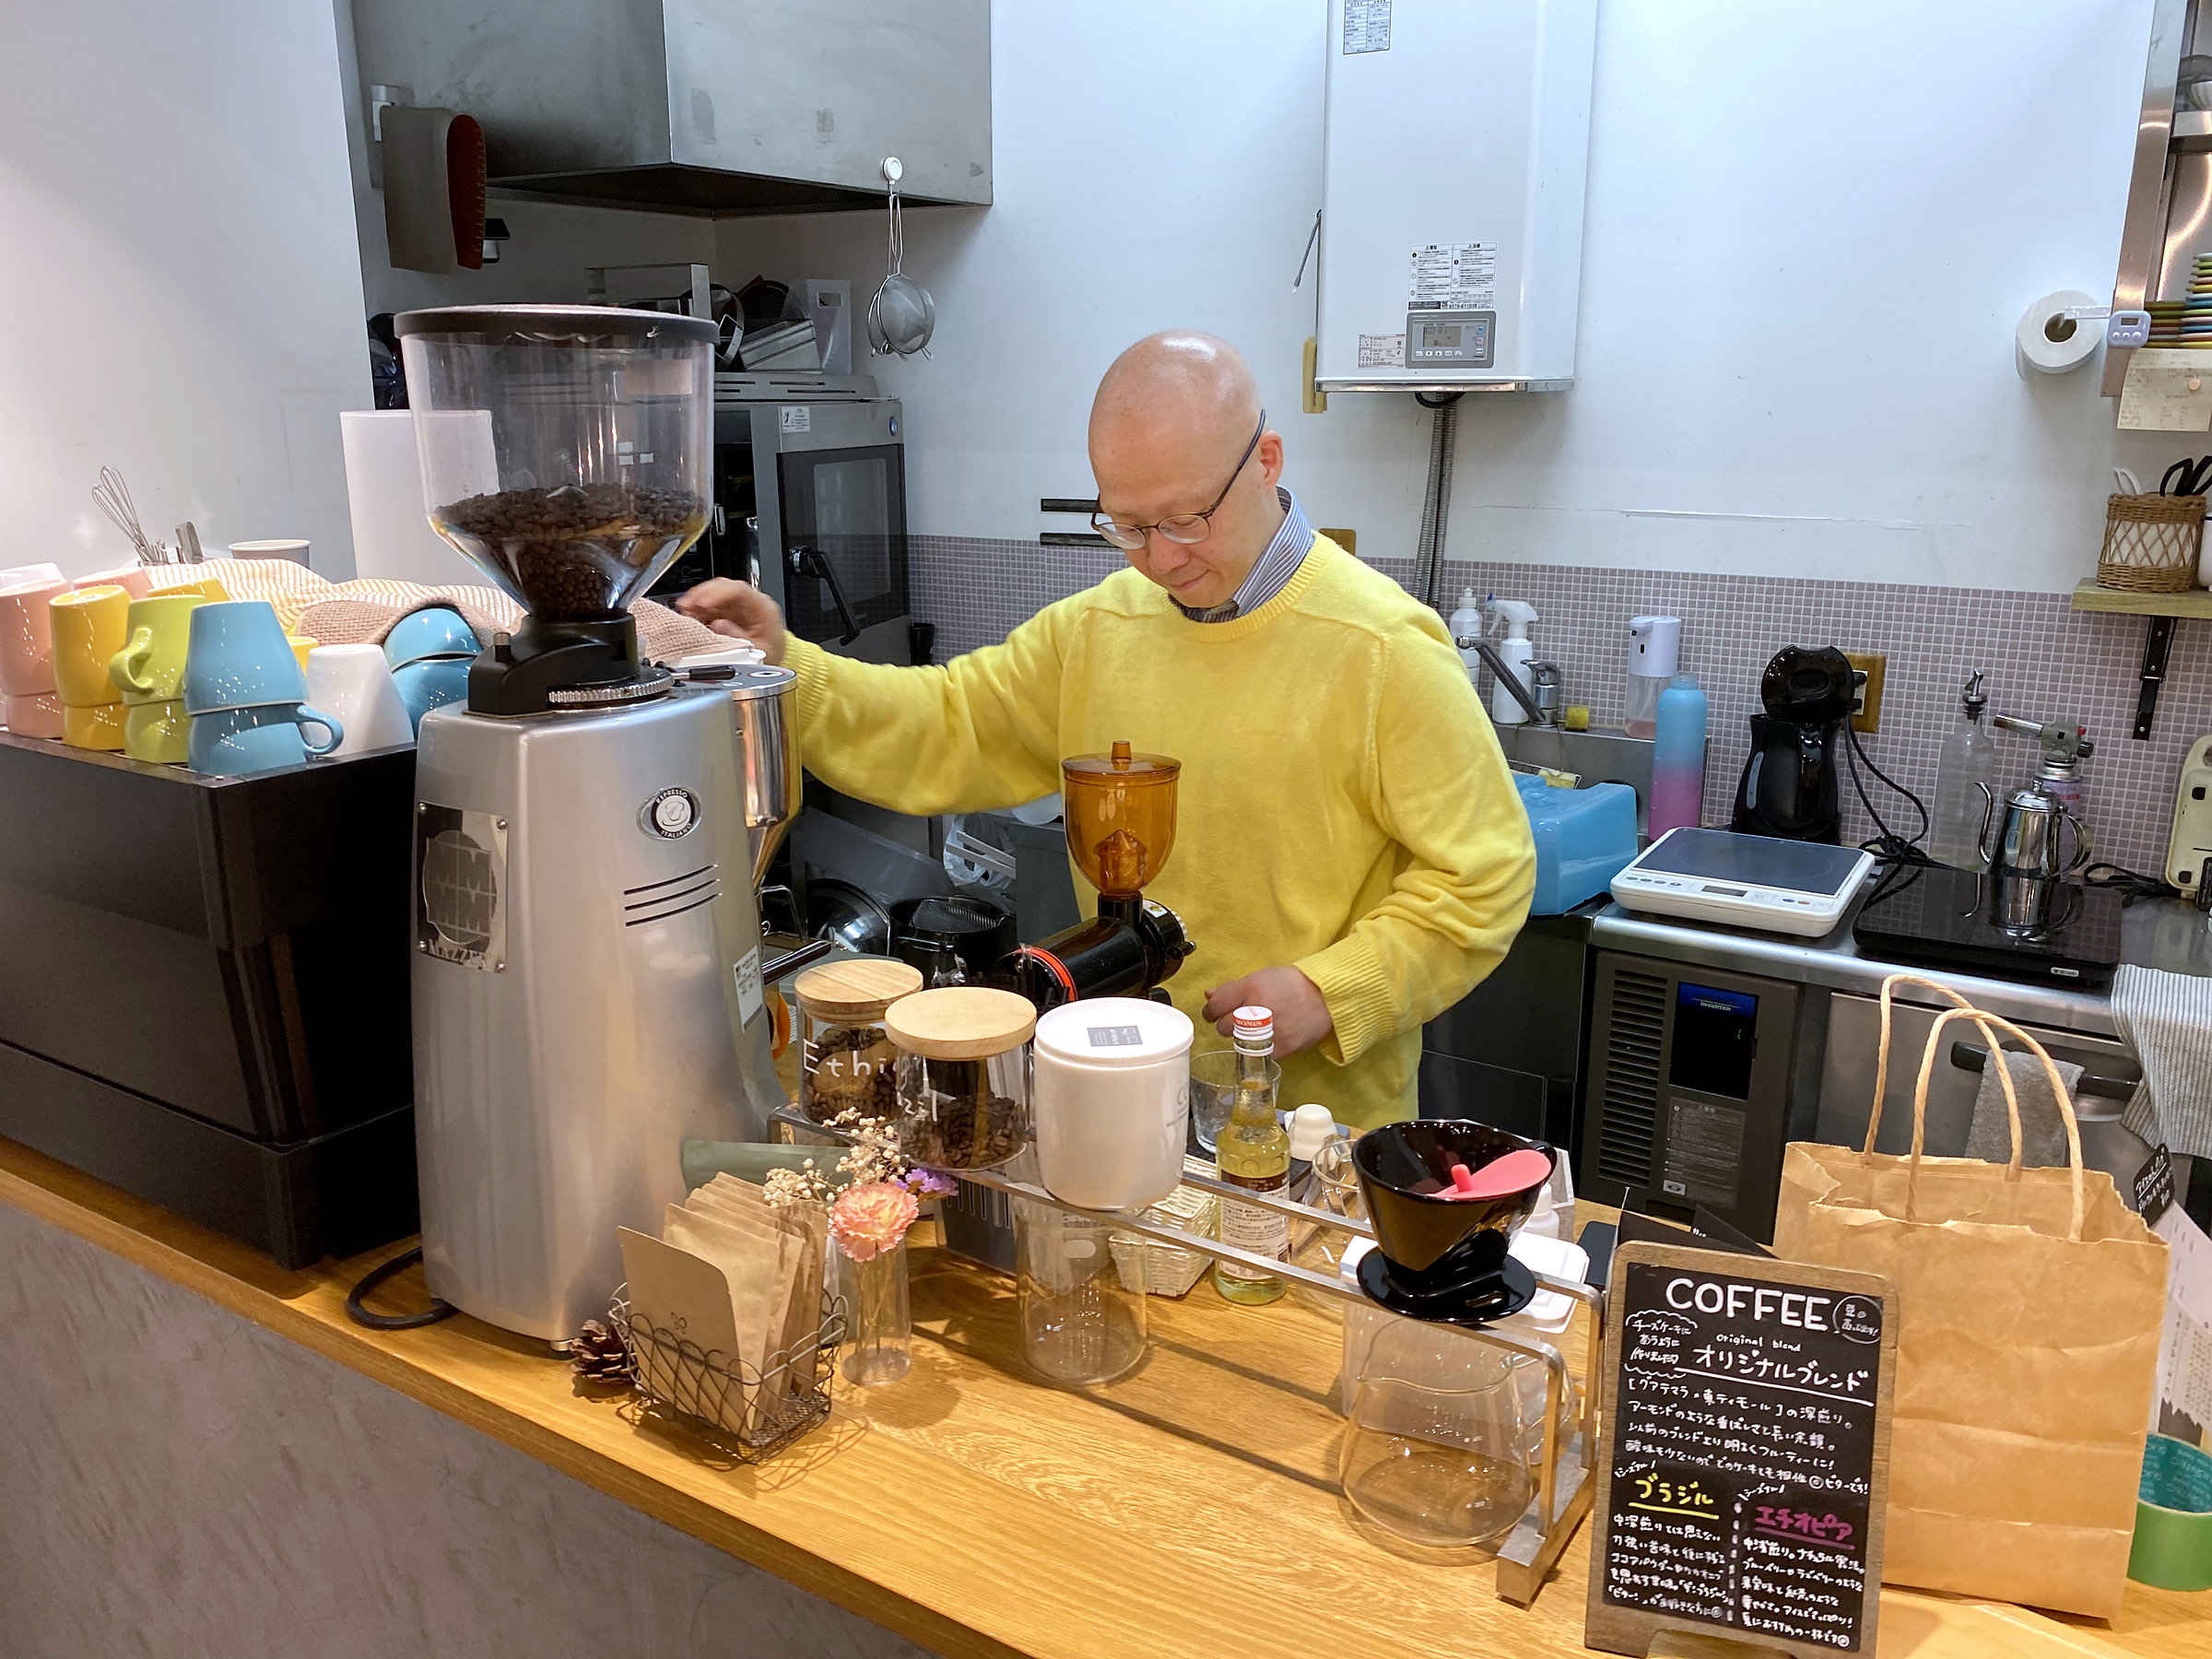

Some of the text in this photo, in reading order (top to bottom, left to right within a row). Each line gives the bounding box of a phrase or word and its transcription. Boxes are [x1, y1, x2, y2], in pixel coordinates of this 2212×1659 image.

[655, 789, 688, 804] ESPRESSO
[660, 822, 692, 839] ITALIANO
[1665, 1277, 1830, 1331] COFFEE
[1715, 1333, 1800, 1351] original blend
[1692, 1344, 1868, 1391] オリジナルブレンド
[1634, 1468, 1713, 1505] ブラジル
[1755, 1506, 1853, 1540] エチオピア
